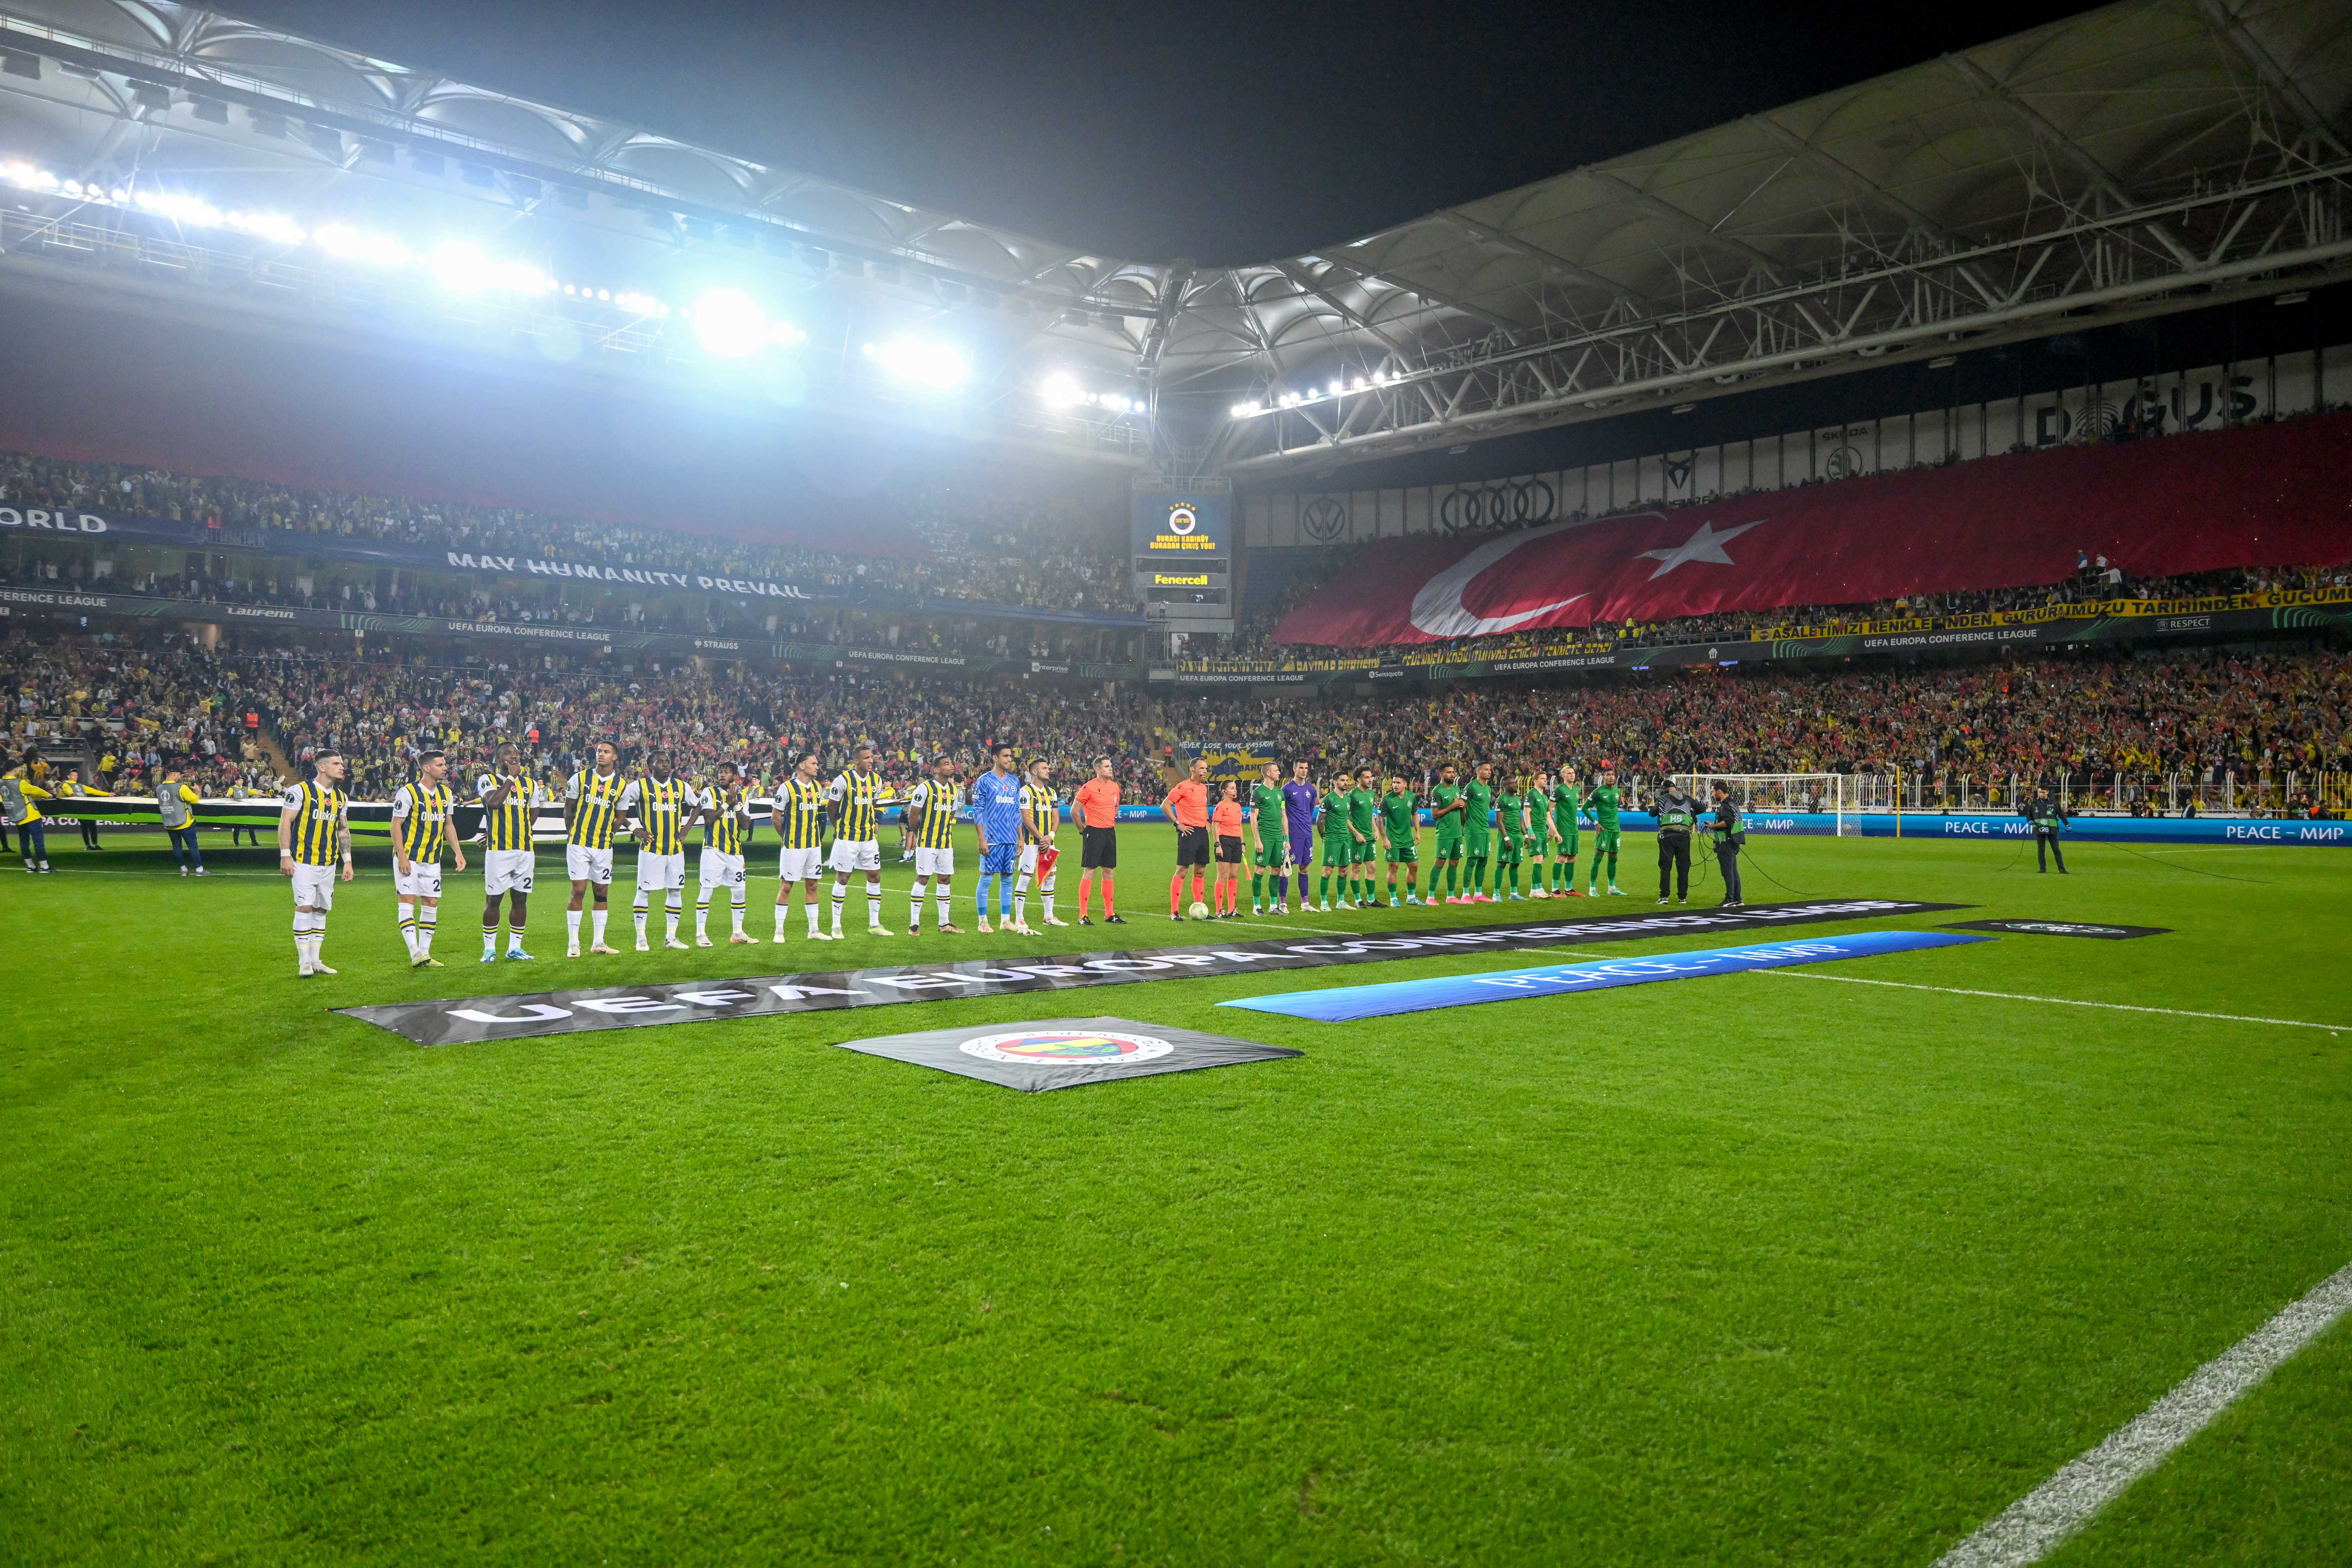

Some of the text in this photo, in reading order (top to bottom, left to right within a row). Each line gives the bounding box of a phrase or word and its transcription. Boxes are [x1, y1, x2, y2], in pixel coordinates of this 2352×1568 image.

[447, 552, 811, 599] MAY HUMANITY PREVAIL
[1155, 575, 1208, 585] Fenercell
[58, 596, 107, 607] LEAGUE
[2171, 618, 2210, 628] RESPECT
[448, 622, 610, 641] UEFA EUROPA CONFERENCE LEAGUE
[1890, 637, 1926, 646] EUROPA
[1929, 632, 1993, 643] CONFERENCE
[1998, 629, 2037, 639] LEAGUE
[703, 640, 738, 650] STRAUSS
[868, 651, 894, 661] EUROPA
[895, 654, 939, 663] CONFERENCE
[941, 656, 965, 665] LEAGUE
[1540, 658, 1585, 668] CONFERENCE
[585, 793, 611, 808] Otokoç
[996, 795, 1014, 805] Otokoç
[653, 802, 677, 812] Otokoç
[421, 811, 446, 822] Otokoç
[1766, 819, 1794, 829] МИР
[1946, 822, 1988, 833] PEACE
[2004, 822, 2032, 834] МИ
[2227, 826, 2281, 839] PEACE
[2300, 827, 2344, 840] МИР
[602, 868, 612, 880] 2
[445, 900, 1922, 1023] UEFA EUROPA CONFERENCE LEAGUE
[1472, 962, 1708, 988] PEACE
